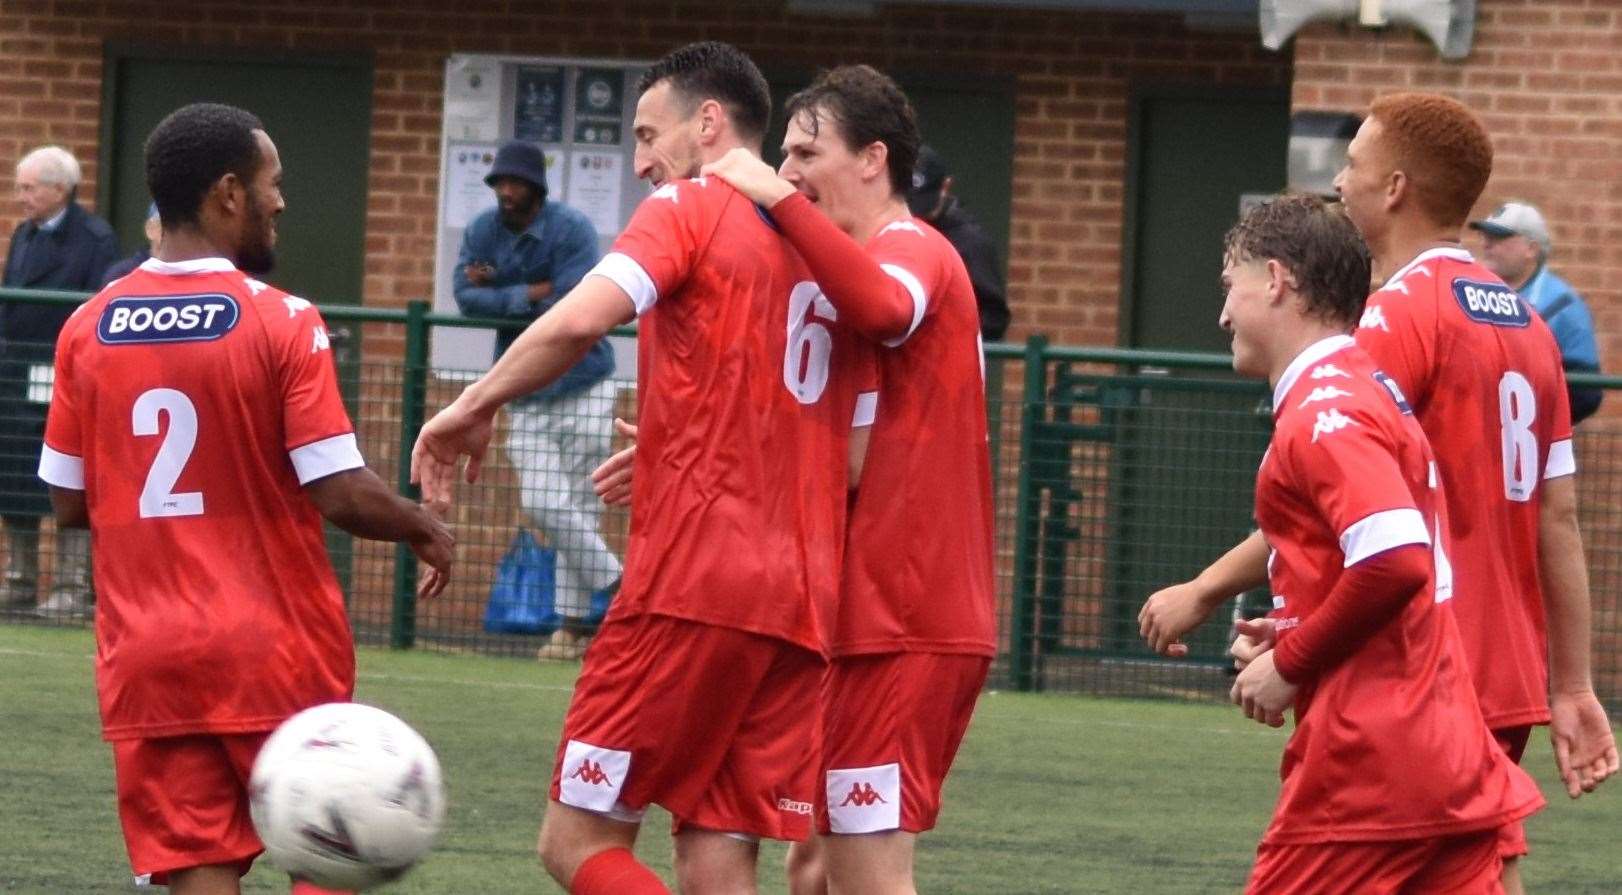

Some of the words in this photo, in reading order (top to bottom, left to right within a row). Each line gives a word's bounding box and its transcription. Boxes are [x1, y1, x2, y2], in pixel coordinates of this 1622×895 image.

[108, 304, 225, 333] BOOST
[783, 281, 837, 404] 6
[1464, 286, 1519, 316] BOOST
[132, 388, 204, 518] 2
[1499, 371, 1538, 501] 8
